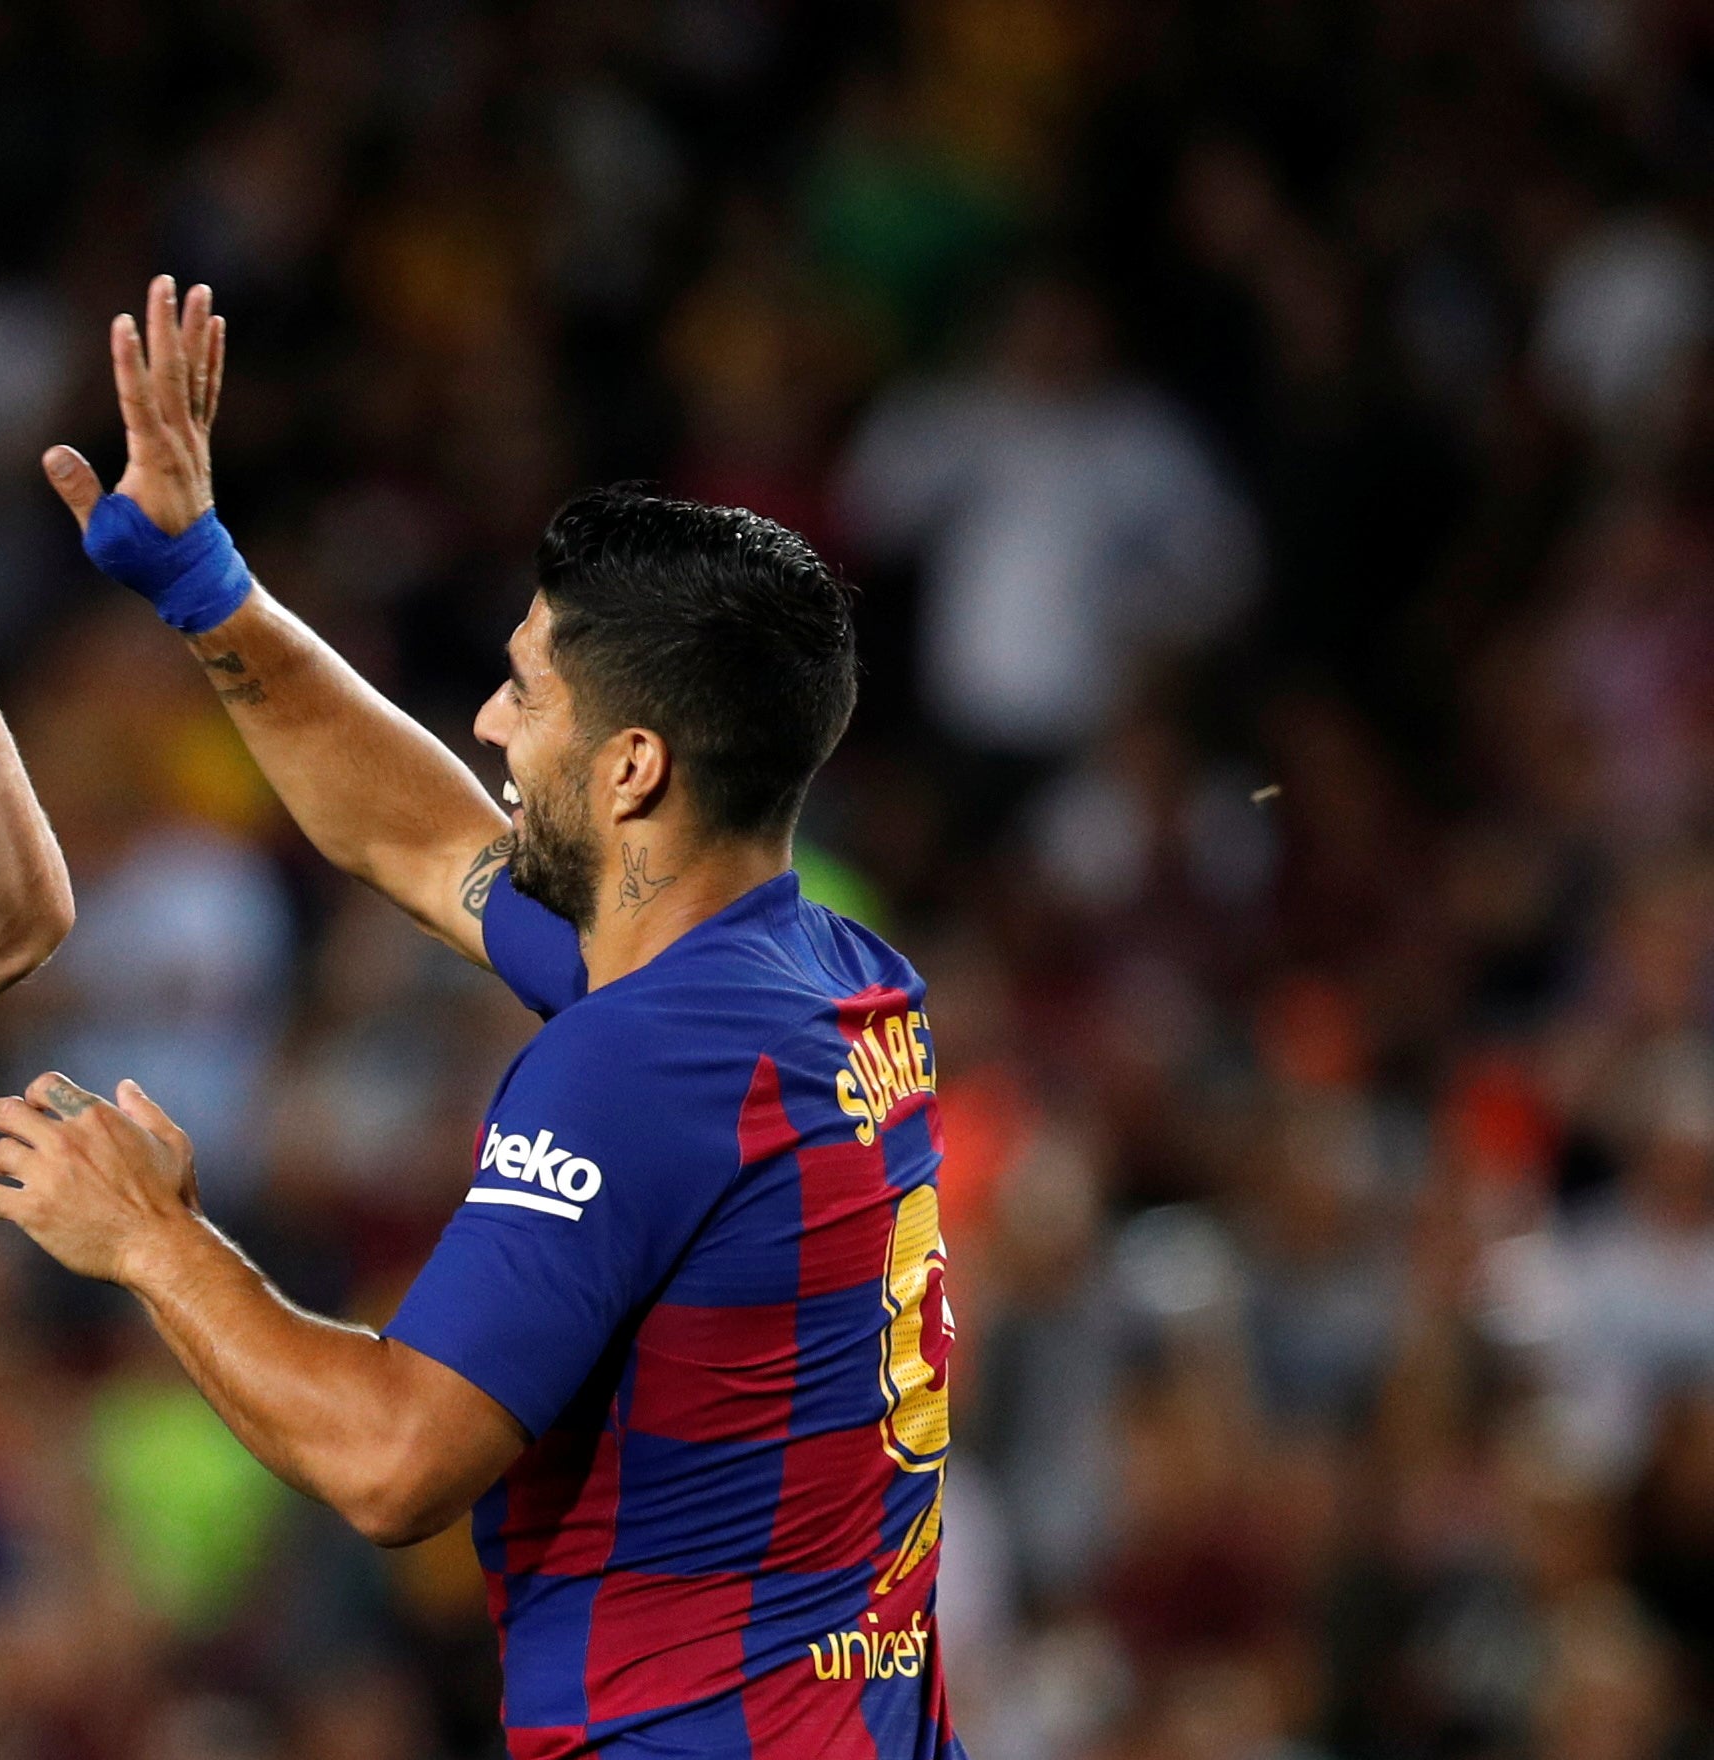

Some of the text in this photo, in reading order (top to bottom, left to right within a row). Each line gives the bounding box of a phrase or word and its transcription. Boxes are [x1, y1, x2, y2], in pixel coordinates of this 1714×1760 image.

[835, 1009, 937, 1147] SUÁRE
[480, 1123, 602, 1203] beko
[807, 1610, 928, 1681] unicef
